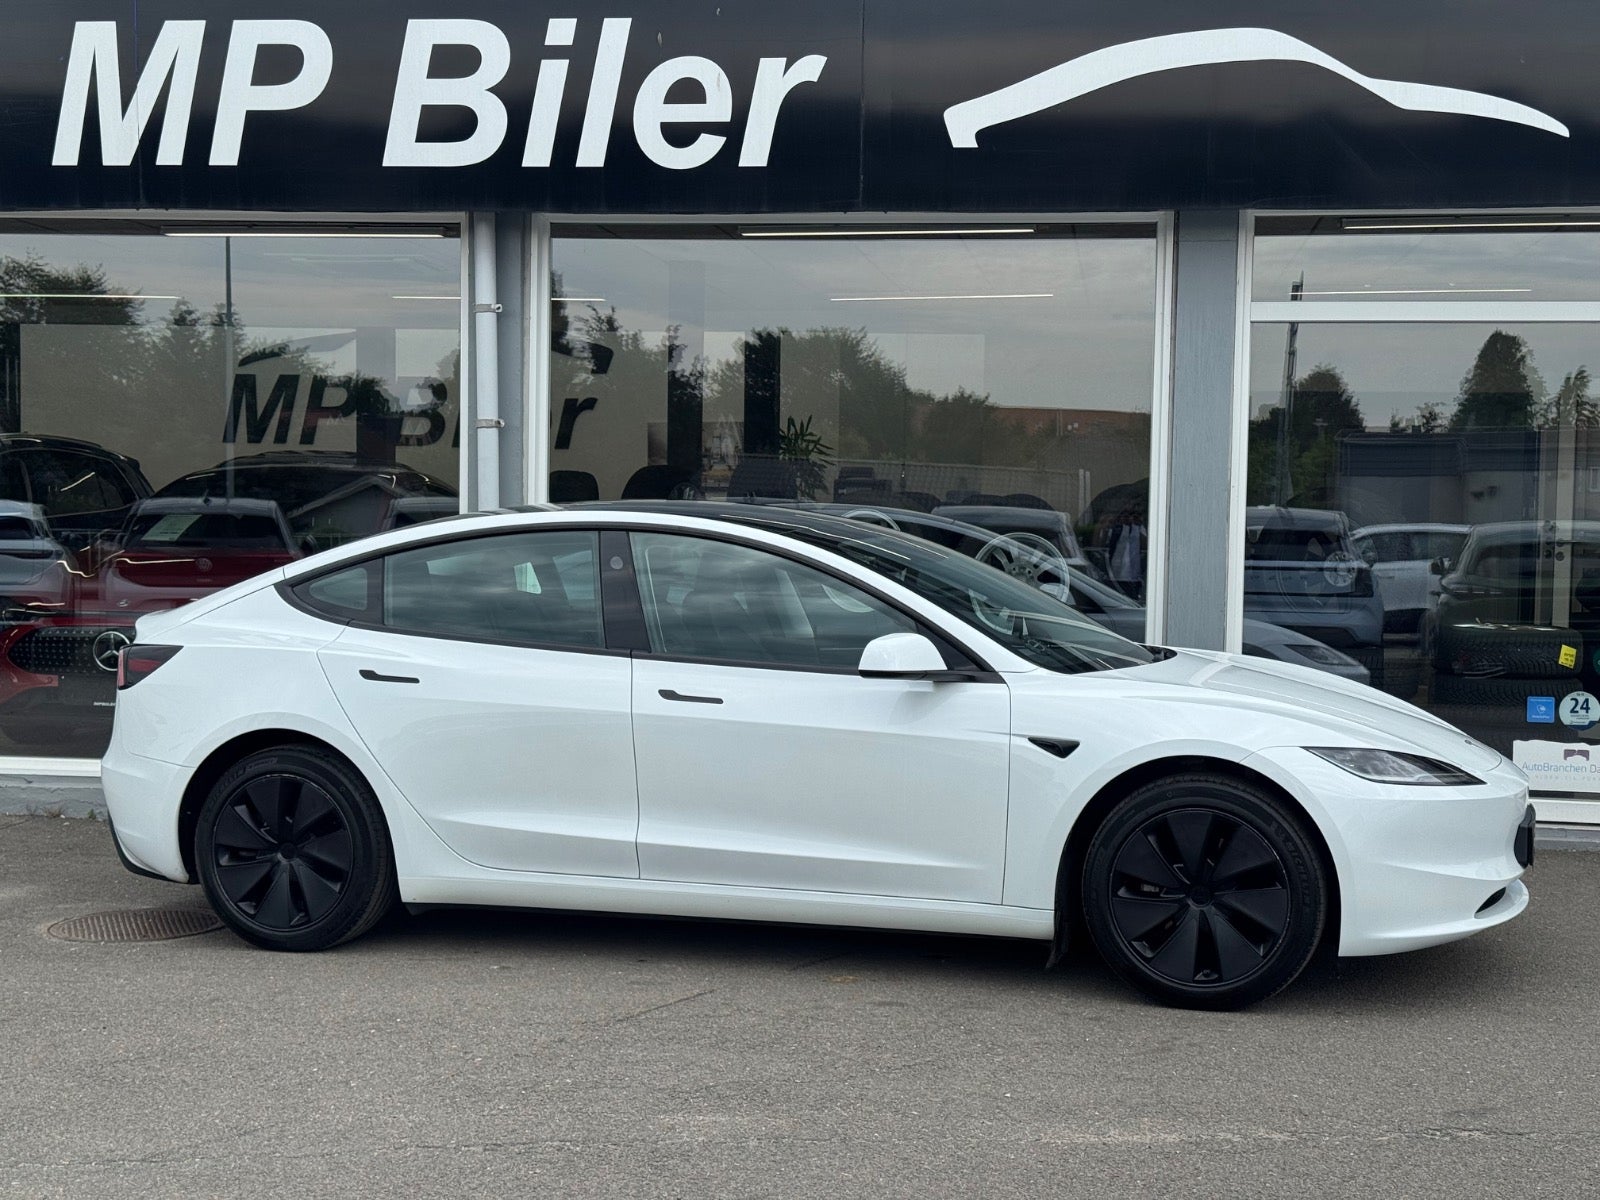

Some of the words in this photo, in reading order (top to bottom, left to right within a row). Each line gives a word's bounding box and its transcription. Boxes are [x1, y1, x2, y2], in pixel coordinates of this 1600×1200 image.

[53, 20, 332, 165] MP
[383, 18, 826, 169] Biler
[1569, 697, 1591, 714] 24
[1522, 761, 1587, 773] AutoBranchen
